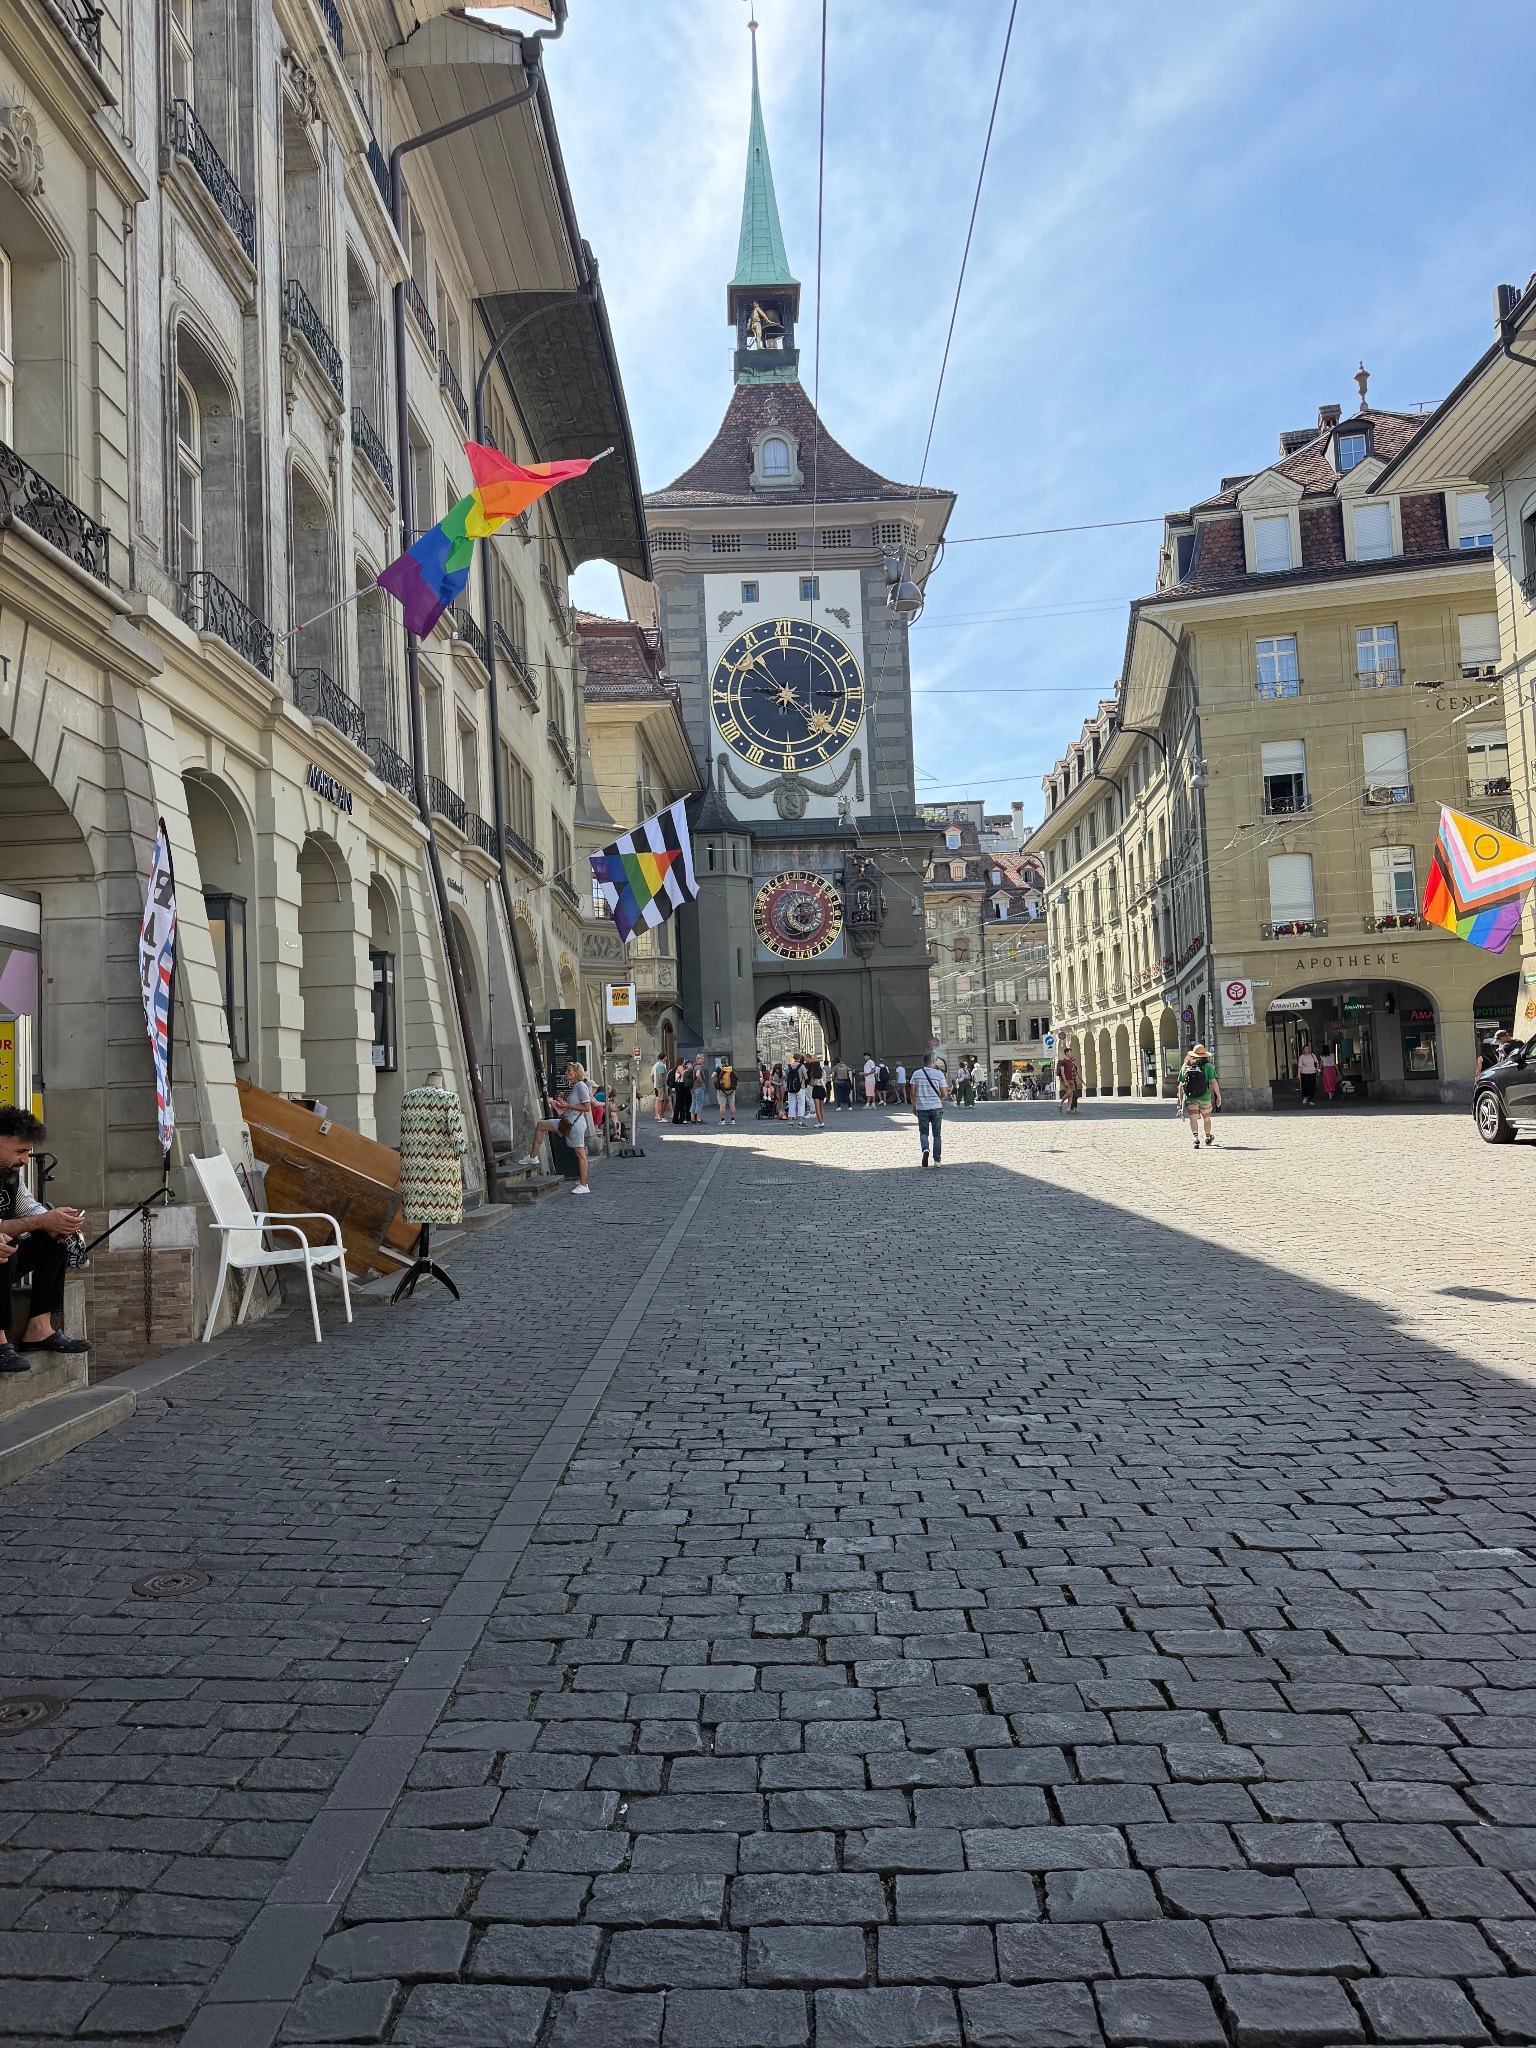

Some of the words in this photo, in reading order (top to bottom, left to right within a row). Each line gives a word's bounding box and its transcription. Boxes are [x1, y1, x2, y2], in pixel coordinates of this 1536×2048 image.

[774, 621, 792, 636] XII
[813, 629, 822, 643] I
[742, 631, 758, 649] XI
[836, 652, 851, 666] II
[713, 689, 728, 704] IX
[847, 686, 862, 700] III
[1436, 693, 1505, 711] CENTR
[1296, 952, 1400, 970] APOTHEKE
